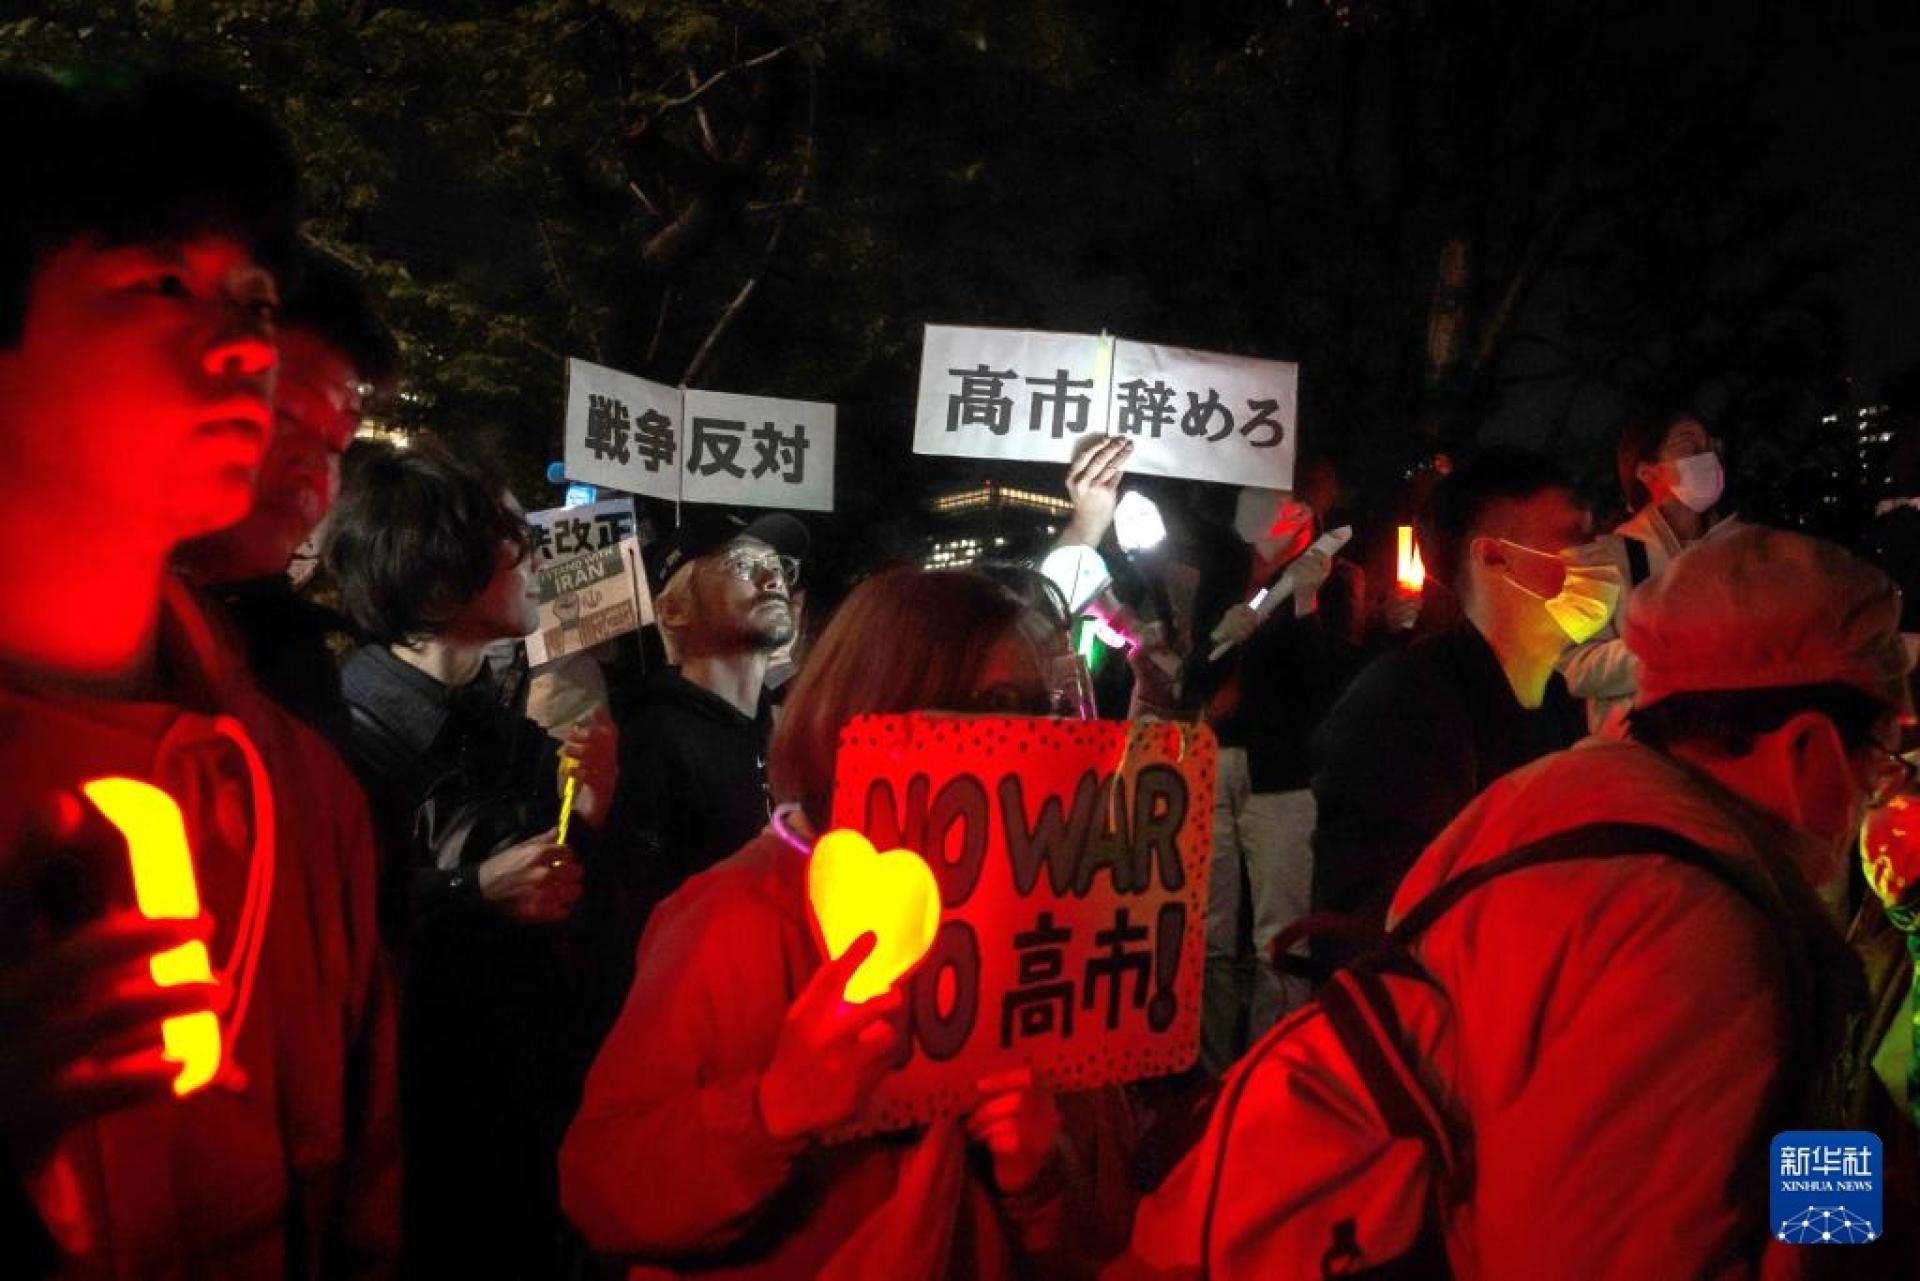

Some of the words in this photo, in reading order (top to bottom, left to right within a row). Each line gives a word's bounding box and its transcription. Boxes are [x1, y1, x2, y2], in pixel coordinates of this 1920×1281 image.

[584, 393, 810, 484] 戦争反対
[946, 364, 1285, 448] 高市辞めろ
[554, 565, 605, 594] IRAN
[997, 763, 1190, 897] WAR
